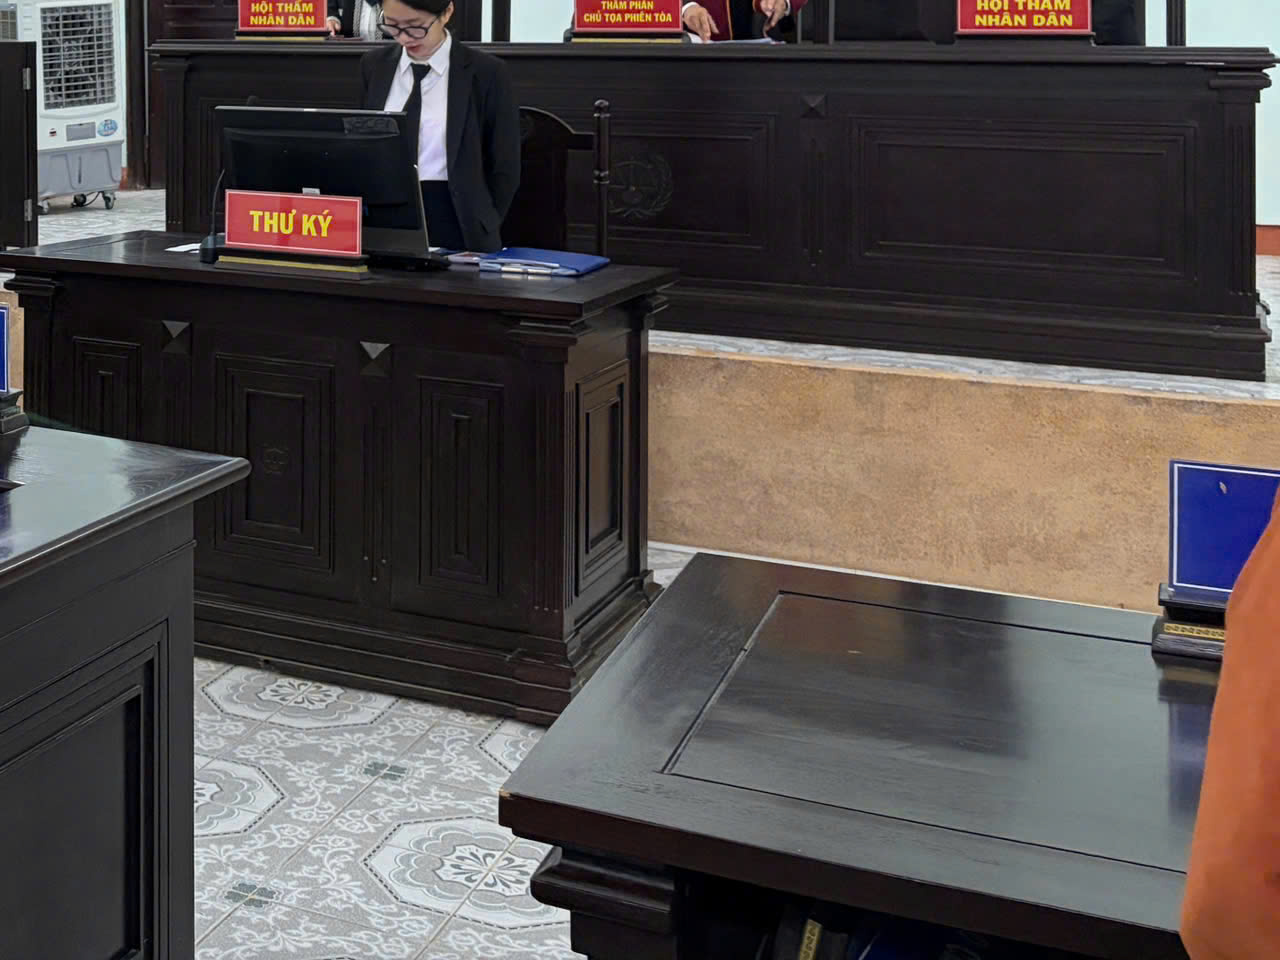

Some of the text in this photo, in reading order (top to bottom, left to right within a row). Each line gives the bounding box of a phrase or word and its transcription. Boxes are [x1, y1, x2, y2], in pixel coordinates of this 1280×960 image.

[250, 0, 273, 14] HỘI
[249, 13, 315, 25] NHÂN DÂN
[583, 10, 673, 24] CHỦ TỌA PHIÊN TÒA
[975, 11, 1073, 27] NHÂN DÂN
[249, 208, 333, 237] THƯ KÝ
